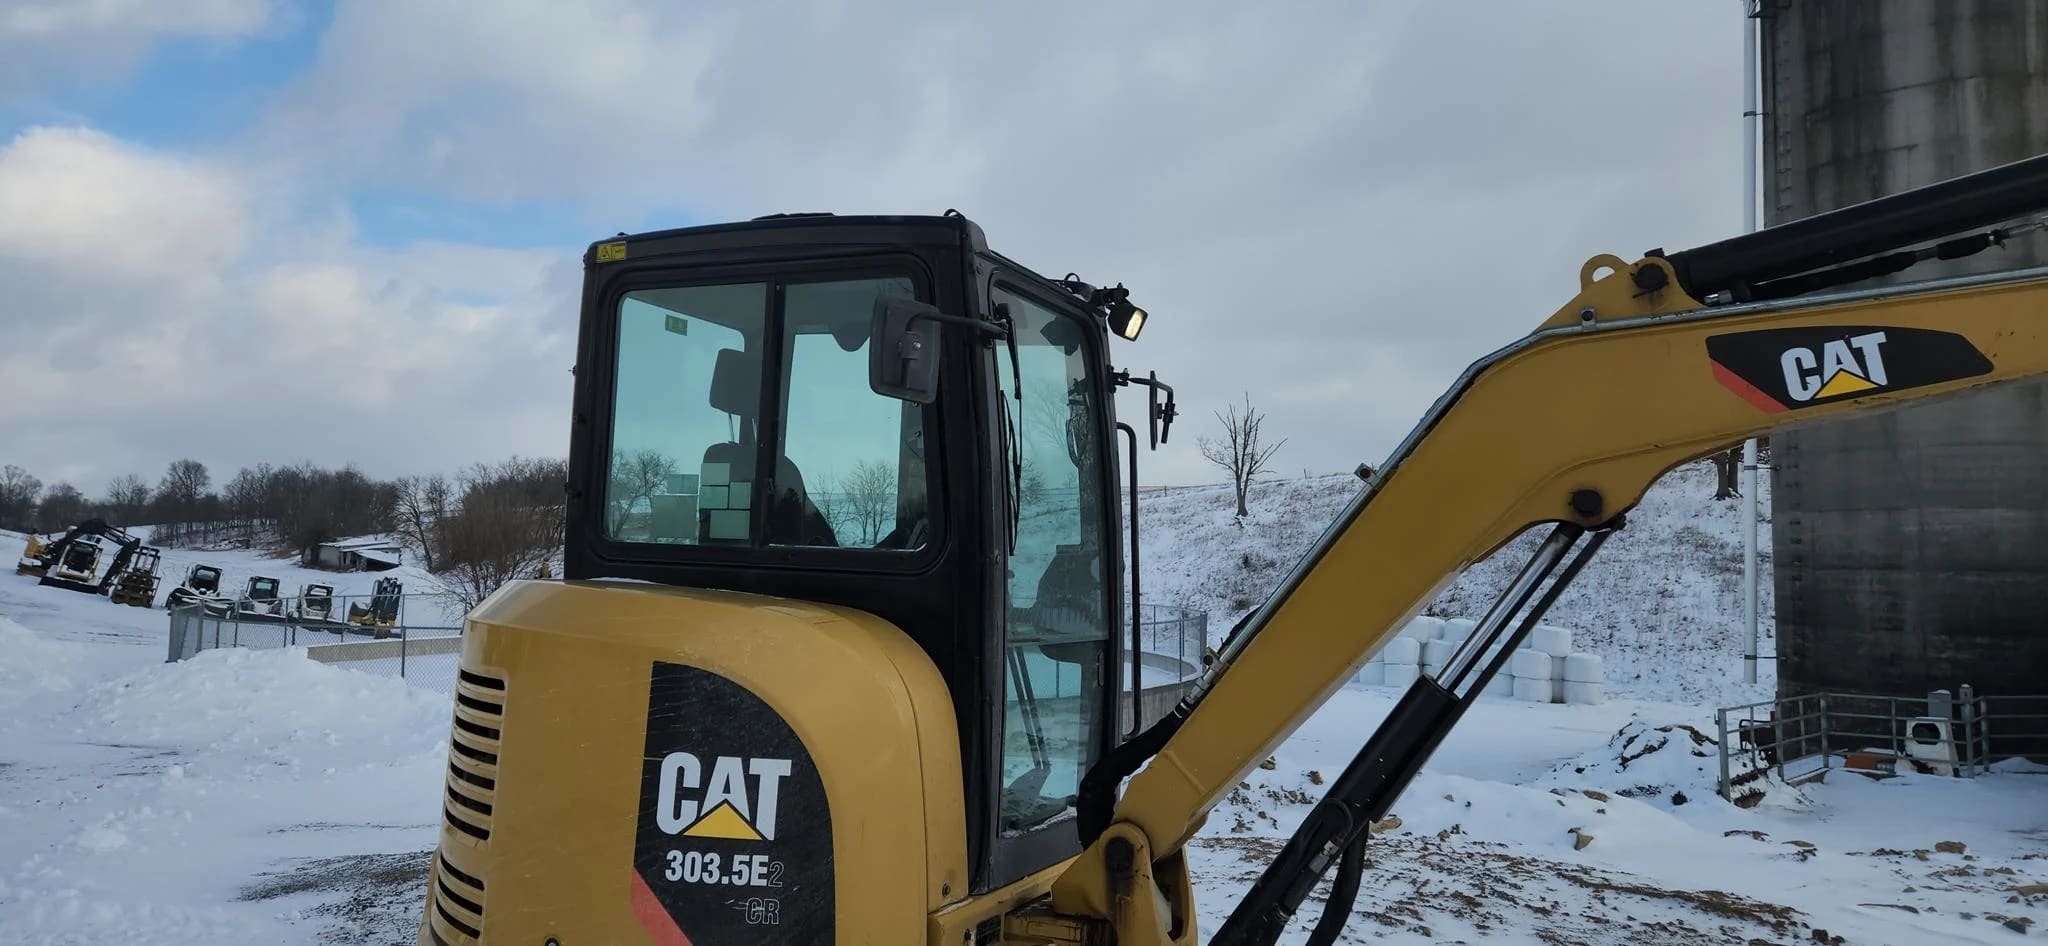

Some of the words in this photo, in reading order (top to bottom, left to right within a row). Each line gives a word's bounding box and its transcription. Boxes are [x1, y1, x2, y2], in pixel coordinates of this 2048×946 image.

[1780, 331, 1888, 401] CAT
[656, 751, 793, 841] CAT
[665, 849, 785, 887] 303.5E2
[745, 897, 780, 924] CR
